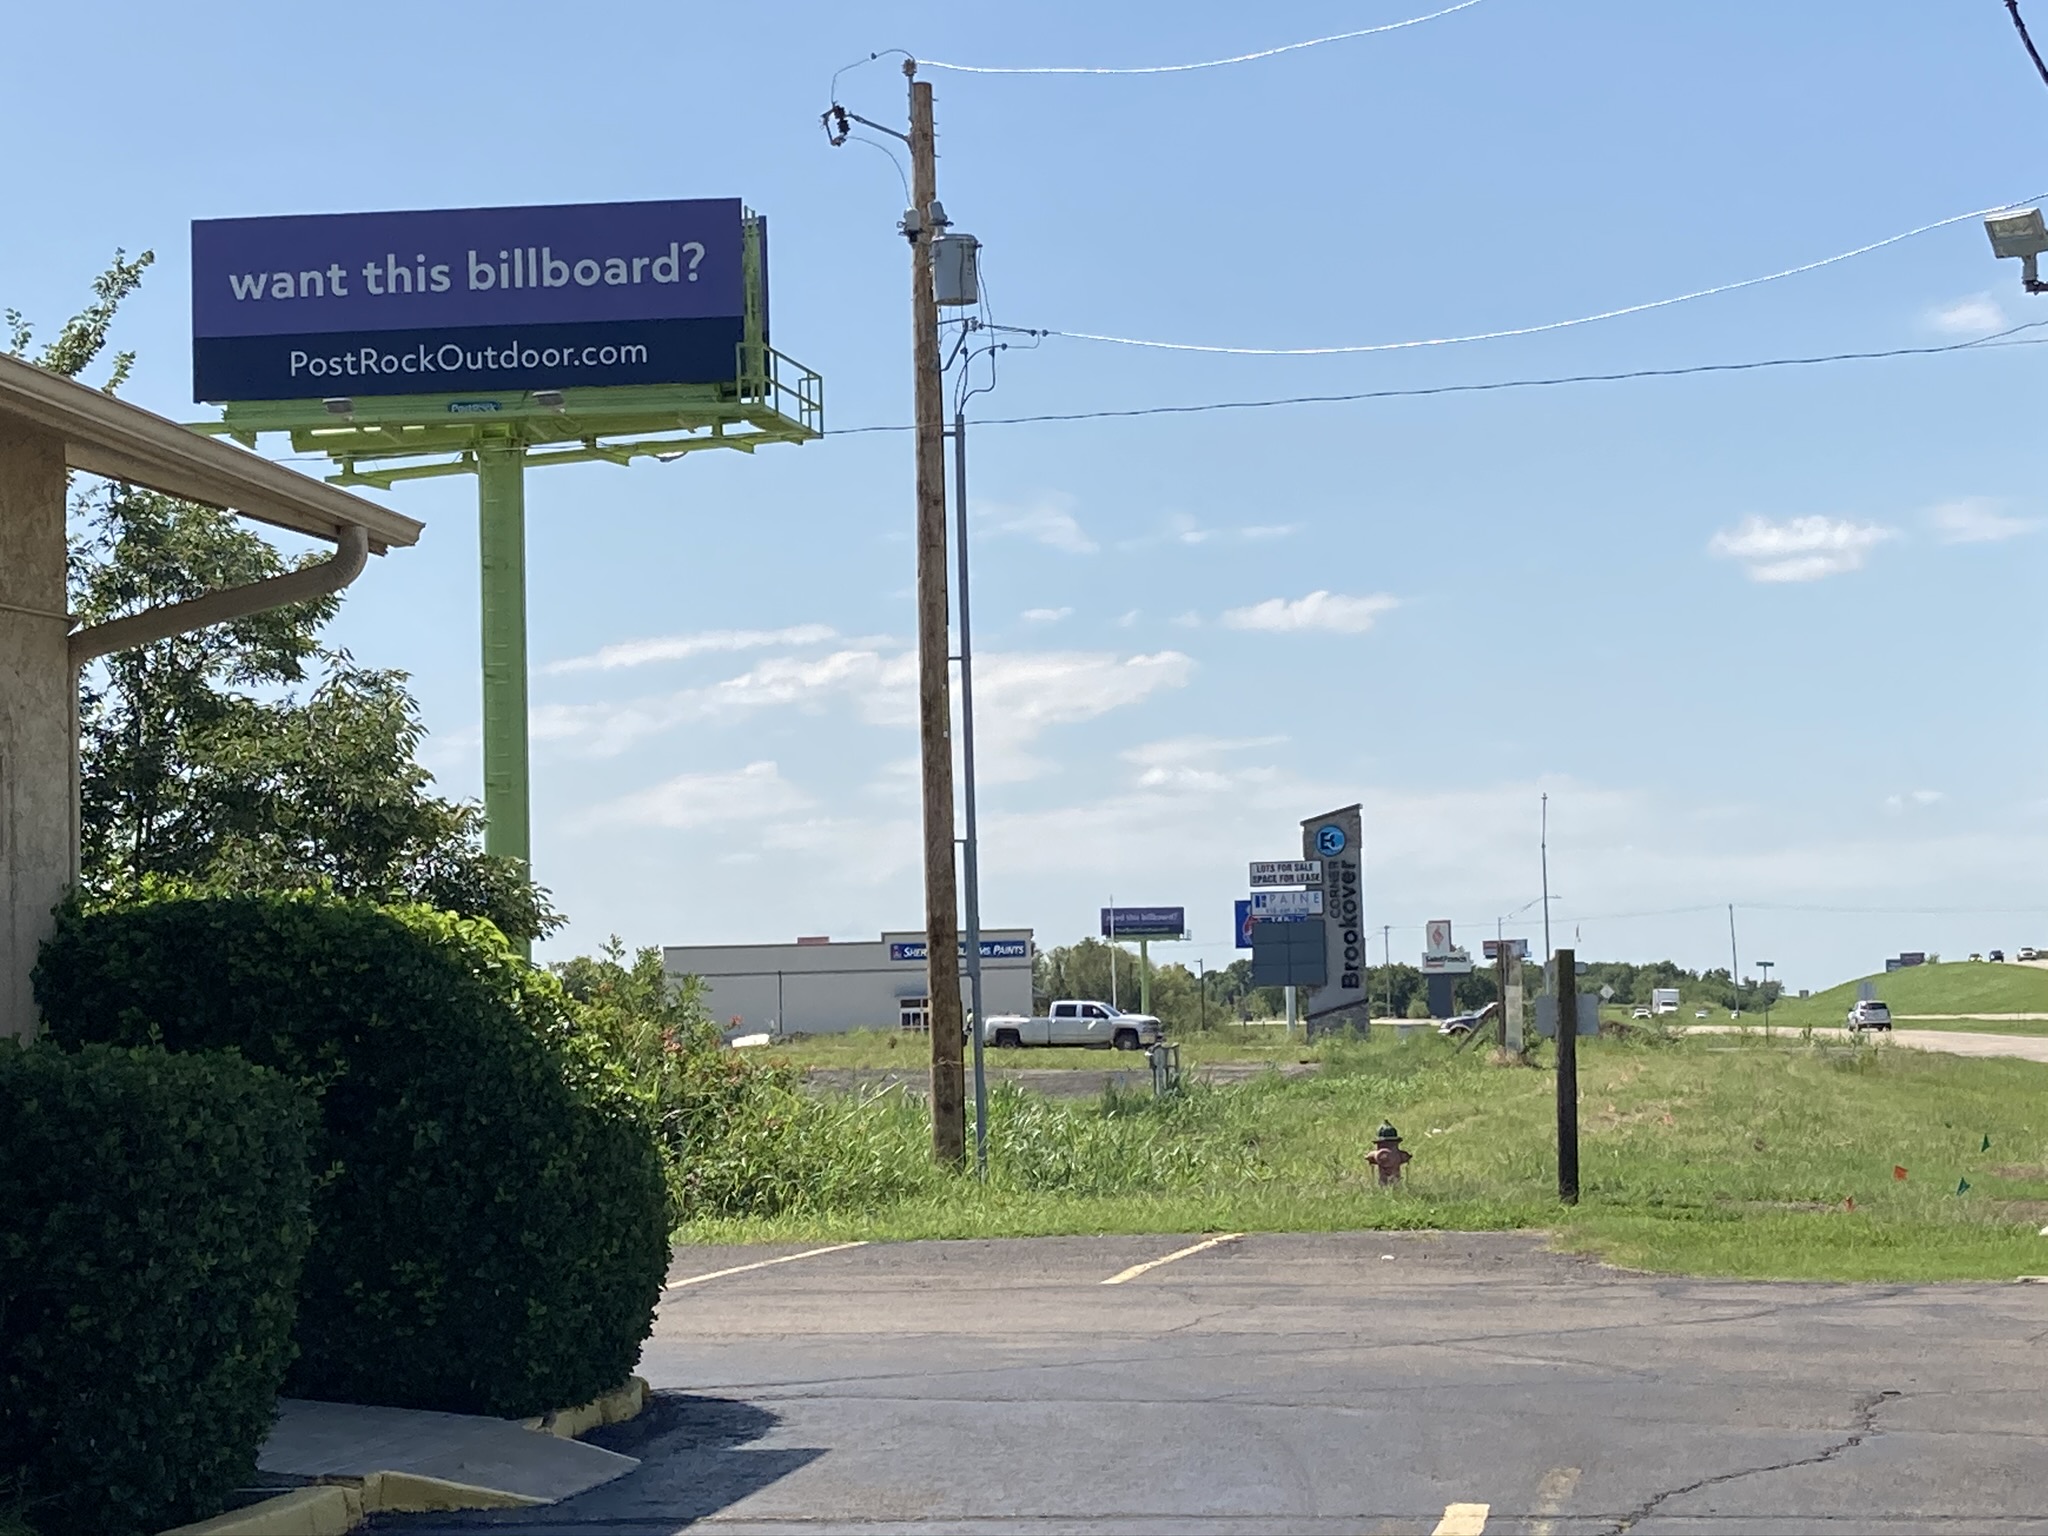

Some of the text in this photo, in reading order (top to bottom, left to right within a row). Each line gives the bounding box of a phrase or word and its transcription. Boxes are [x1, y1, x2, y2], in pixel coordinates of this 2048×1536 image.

[229, 241, 706, 301] want this billboard?
[290, 340, 648, 377] PostRockOutdoor.com
[1252, 872, 1320, 884] SPACE FOR LEASE
[1257, 862, 1313, 873] LOTS FOR SALE
[1269, 892, 1320, 905] PAINE
[1328, 861, 1341, 919] CORNER
[1339, 860, 1360, 988] Brookover
[993, 944, 1024, 956] PAINTS
